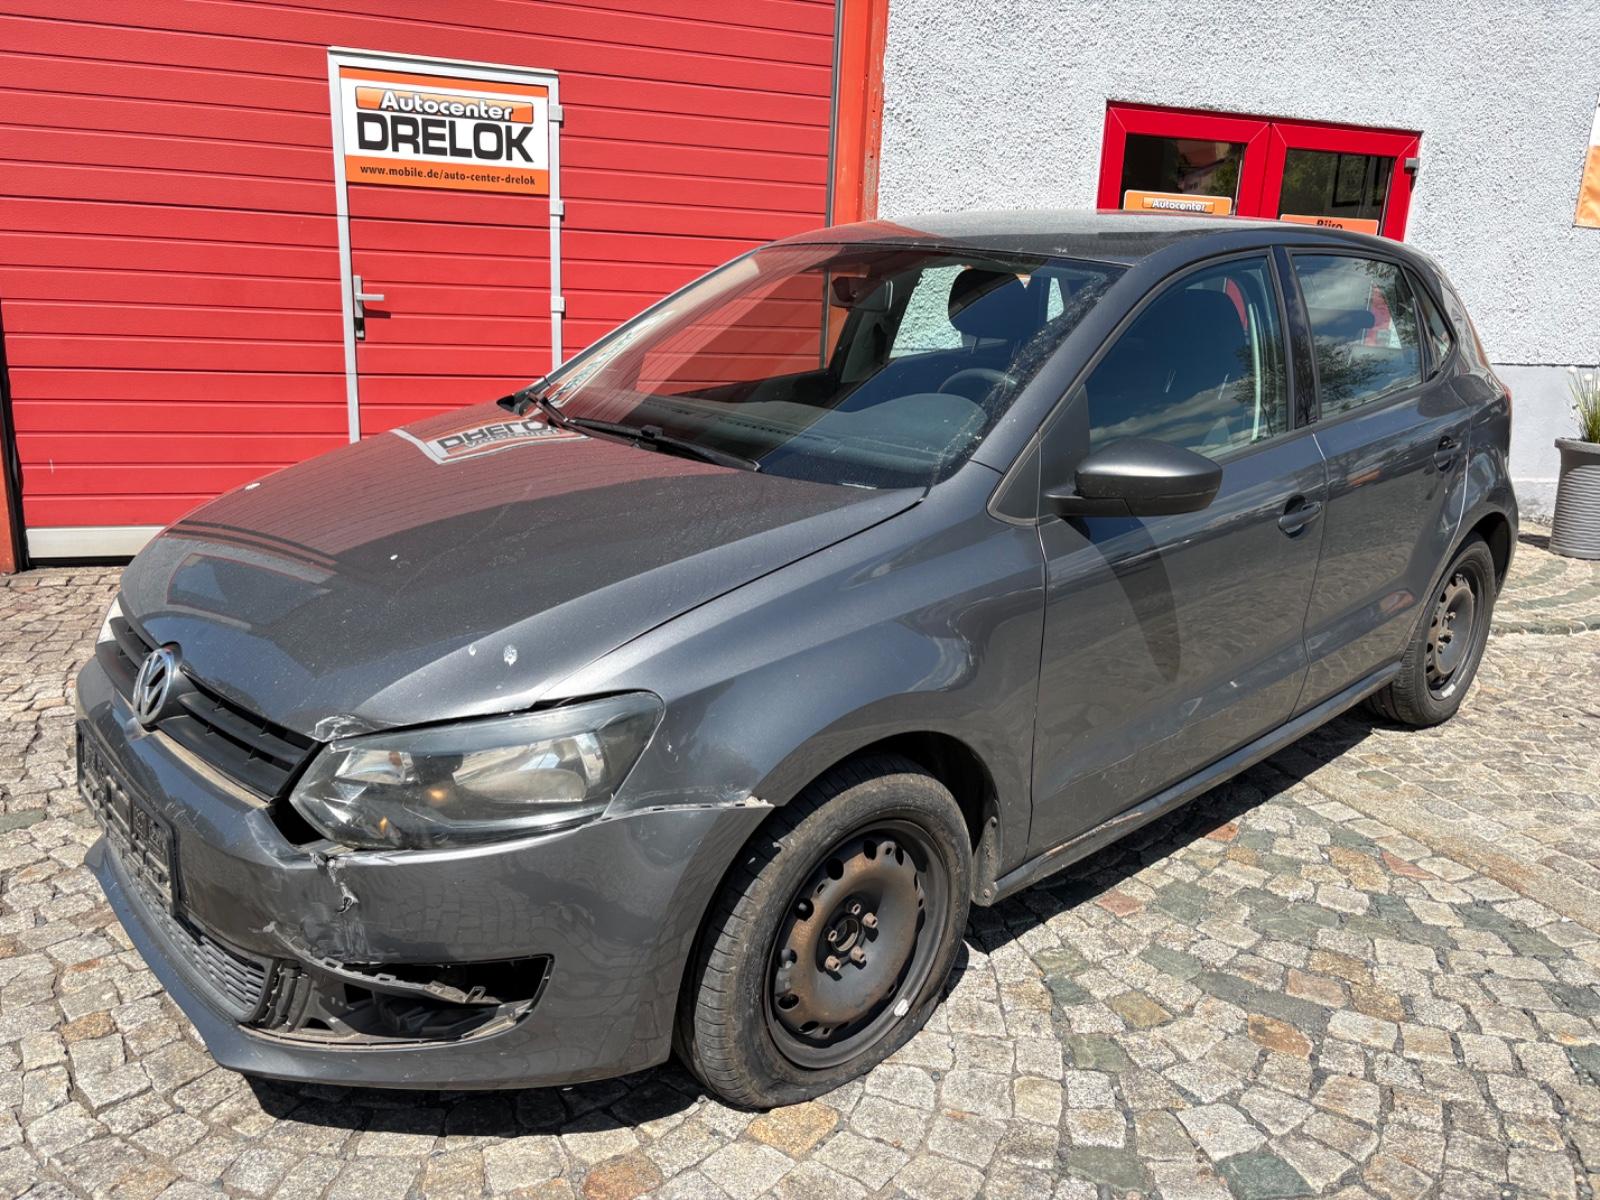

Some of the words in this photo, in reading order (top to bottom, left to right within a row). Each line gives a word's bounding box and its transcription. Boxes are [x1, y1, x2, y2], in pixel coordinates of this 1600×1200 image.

[380, 91, 514, 121] Autocenter
[357, 112, 534, 163] DRELOK
[360, 164, 536, 186] www.mobile.de/auto-center-drelok
[1152, 199, 1206, 211] Autocenter
